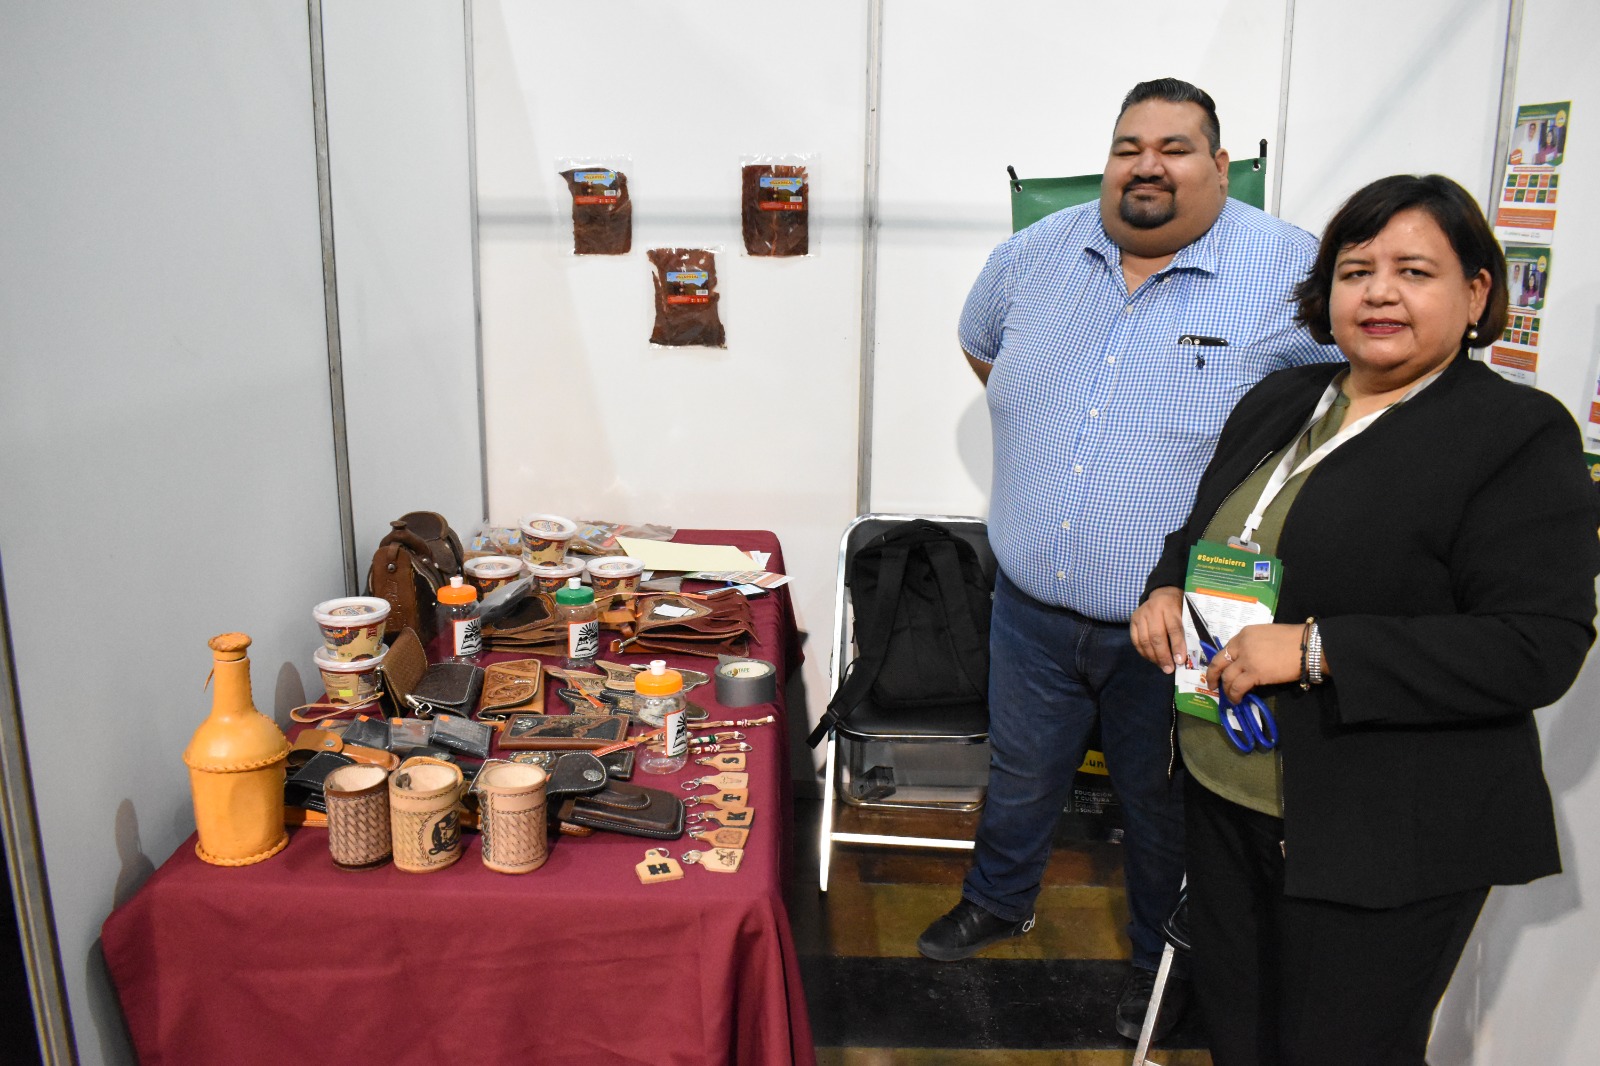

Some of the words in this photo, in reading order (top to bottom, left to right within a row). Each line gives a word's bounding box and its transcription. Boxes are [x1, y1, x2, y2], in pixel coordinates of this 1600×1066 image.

[1197, 554, 1246, 568] #SoyUnisierra
[722, 756, 740, 765] S
[1074, 789, 1113, 798] EDUCACIÓN
[726, 811, 747, 821] K
[646, 862, 671, 876] H
